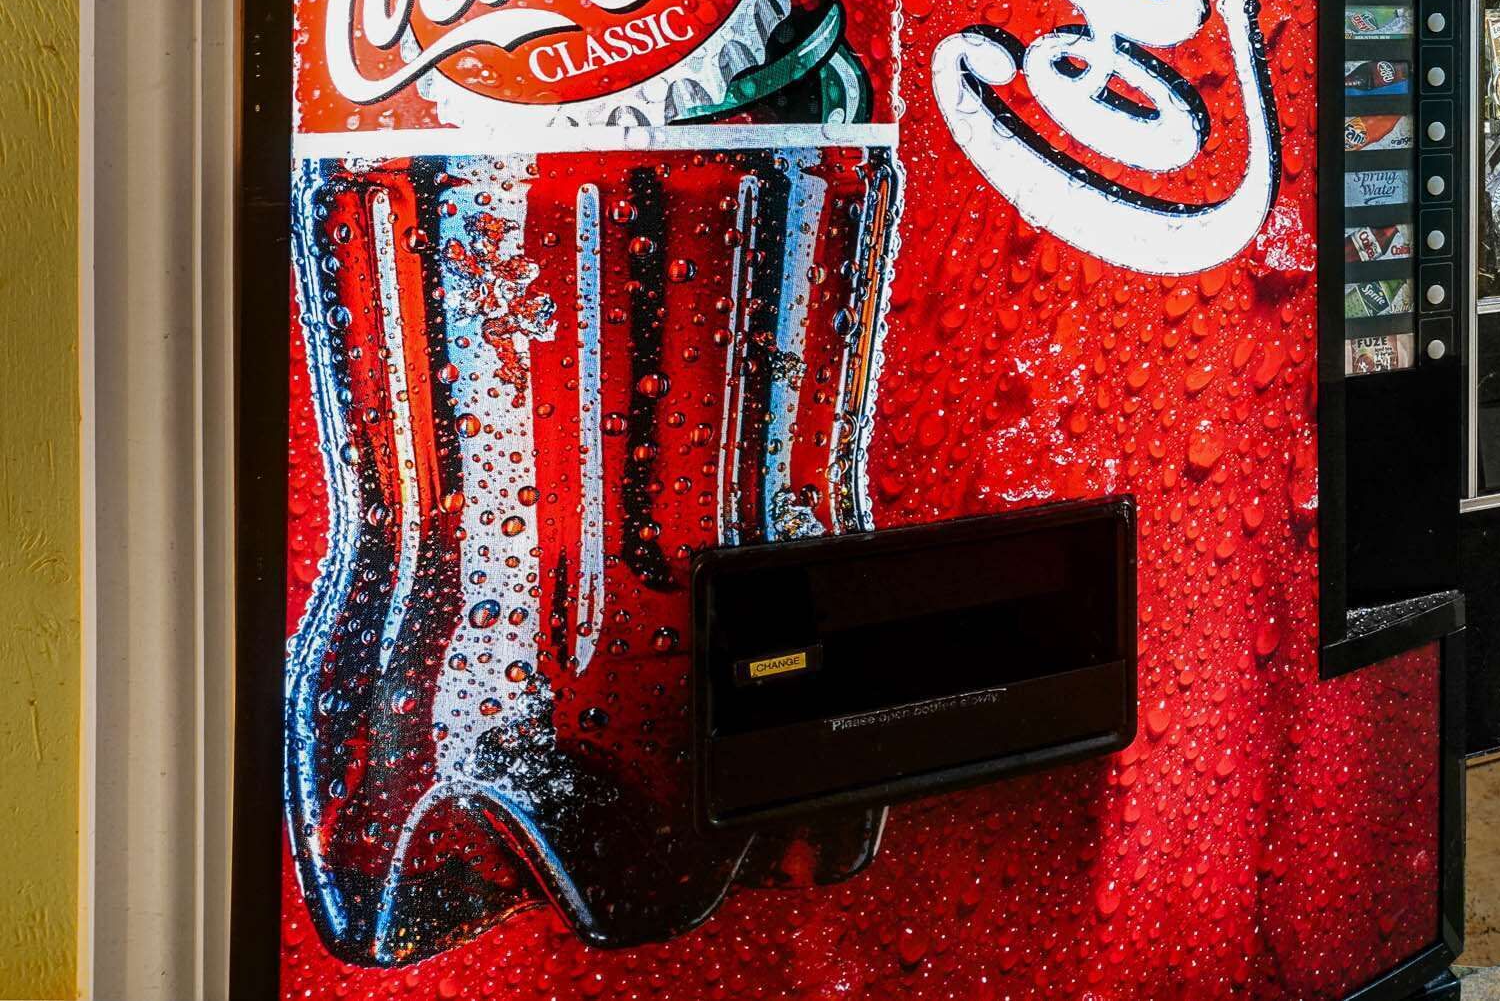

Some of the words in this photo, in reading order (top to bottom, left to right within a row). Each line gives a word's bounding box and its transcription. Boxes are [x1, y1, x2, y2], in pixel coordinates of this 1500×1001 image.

[529, 6, 694, 83] CLASSIC
[1360, 183, 1399, 196] Water
[1361, 284, 1386, 305] Sprite
[1357, 336, 1387, 349] FUZE
[756, 655, 801, 673] CHANGE
[832, 714, 875, 732] Please
